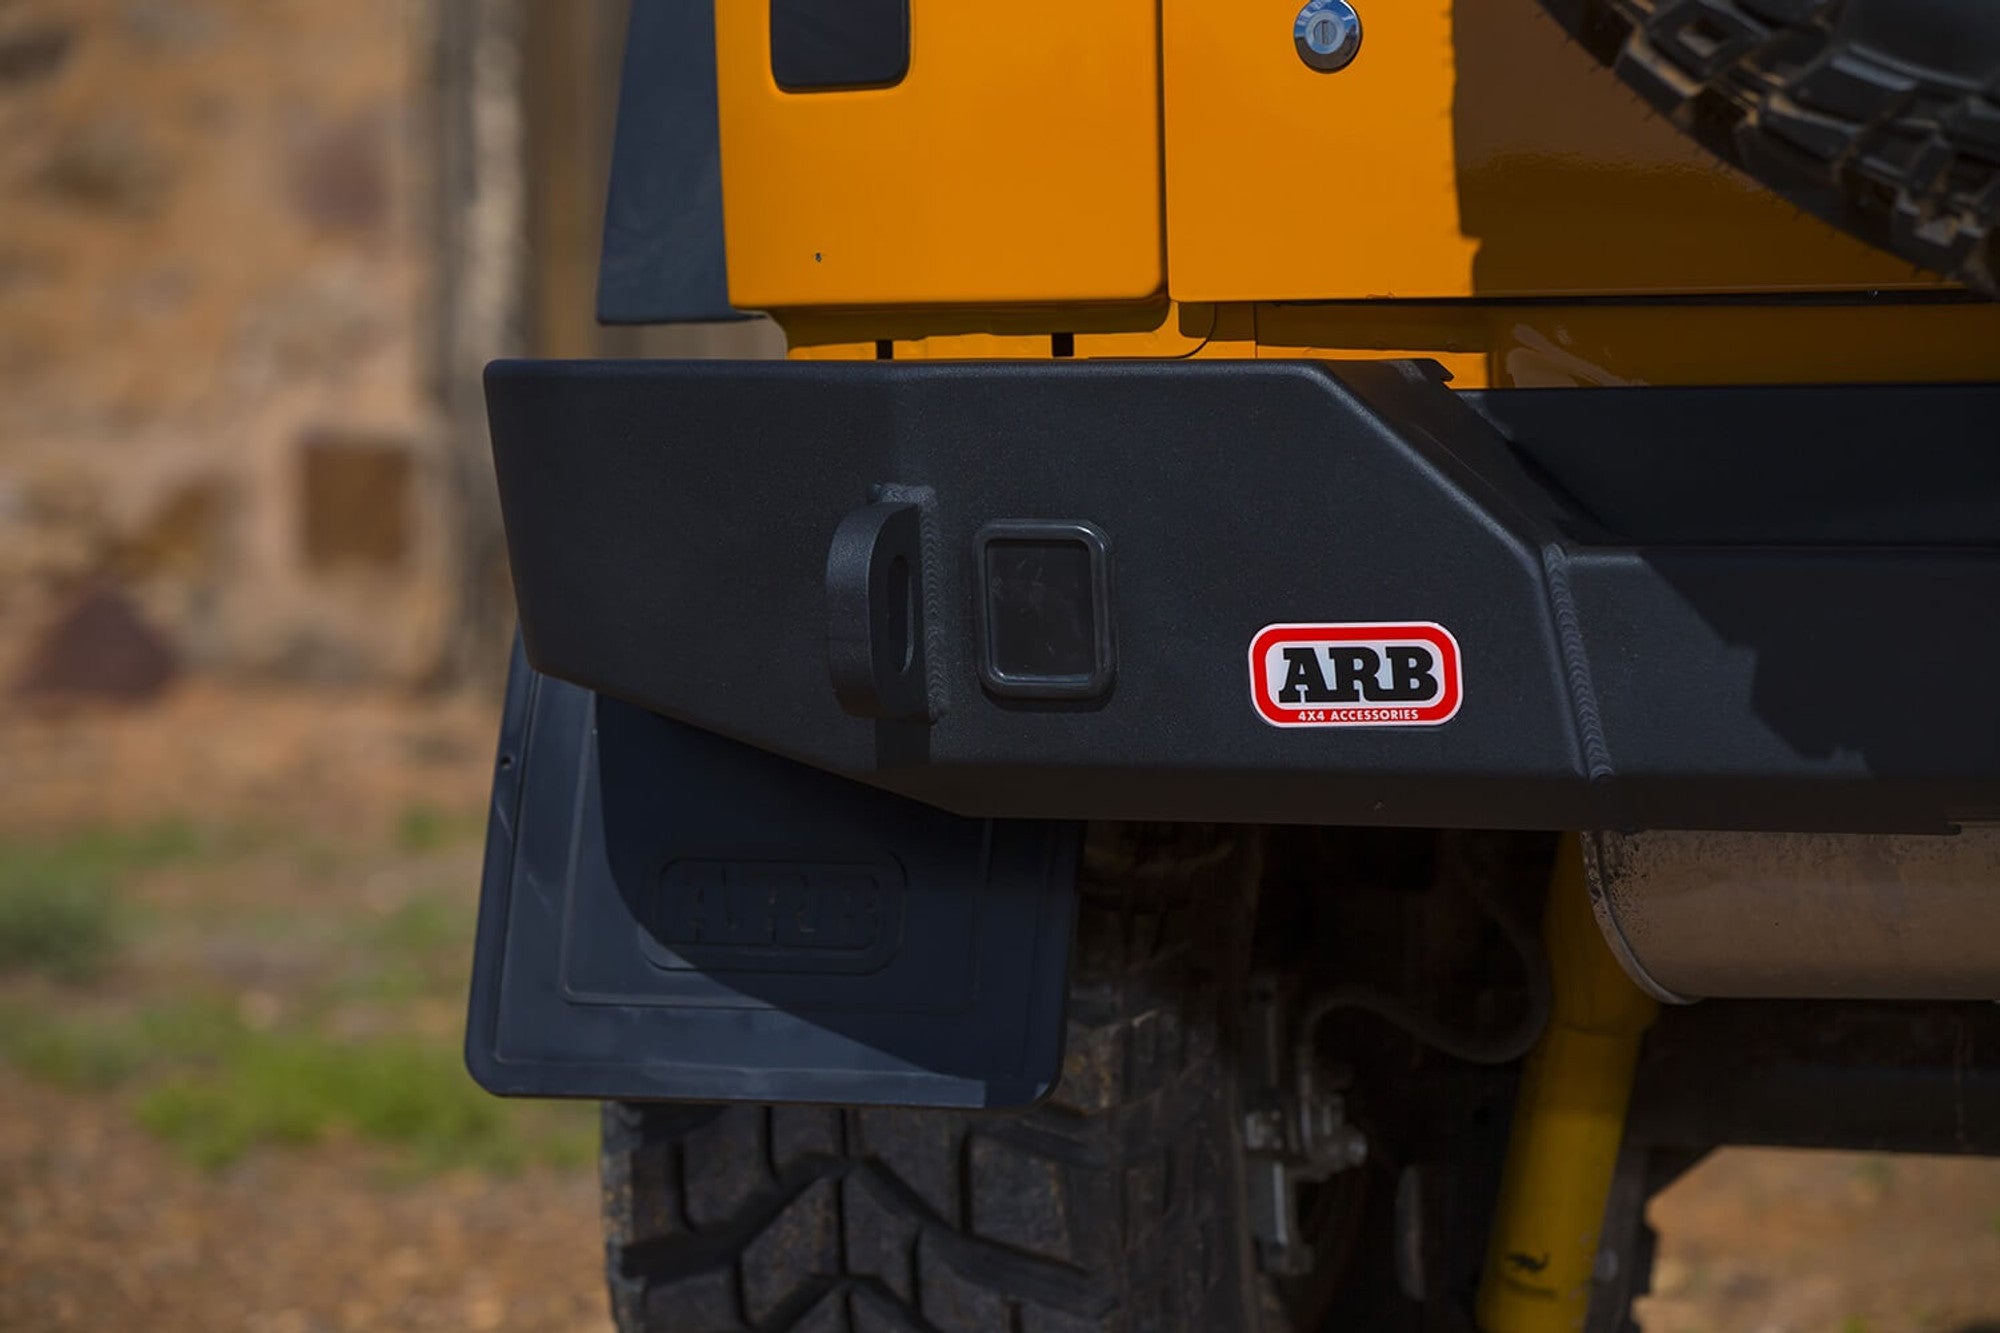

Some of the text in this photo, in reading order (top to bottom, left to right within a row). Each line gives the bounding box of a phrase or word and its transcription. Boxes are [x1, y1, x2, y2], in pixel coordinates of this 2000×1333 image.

[1280, 647, 1438, 702] ARB
[1298, 709, 1419, 721] 4X4 ACCESSORIES
